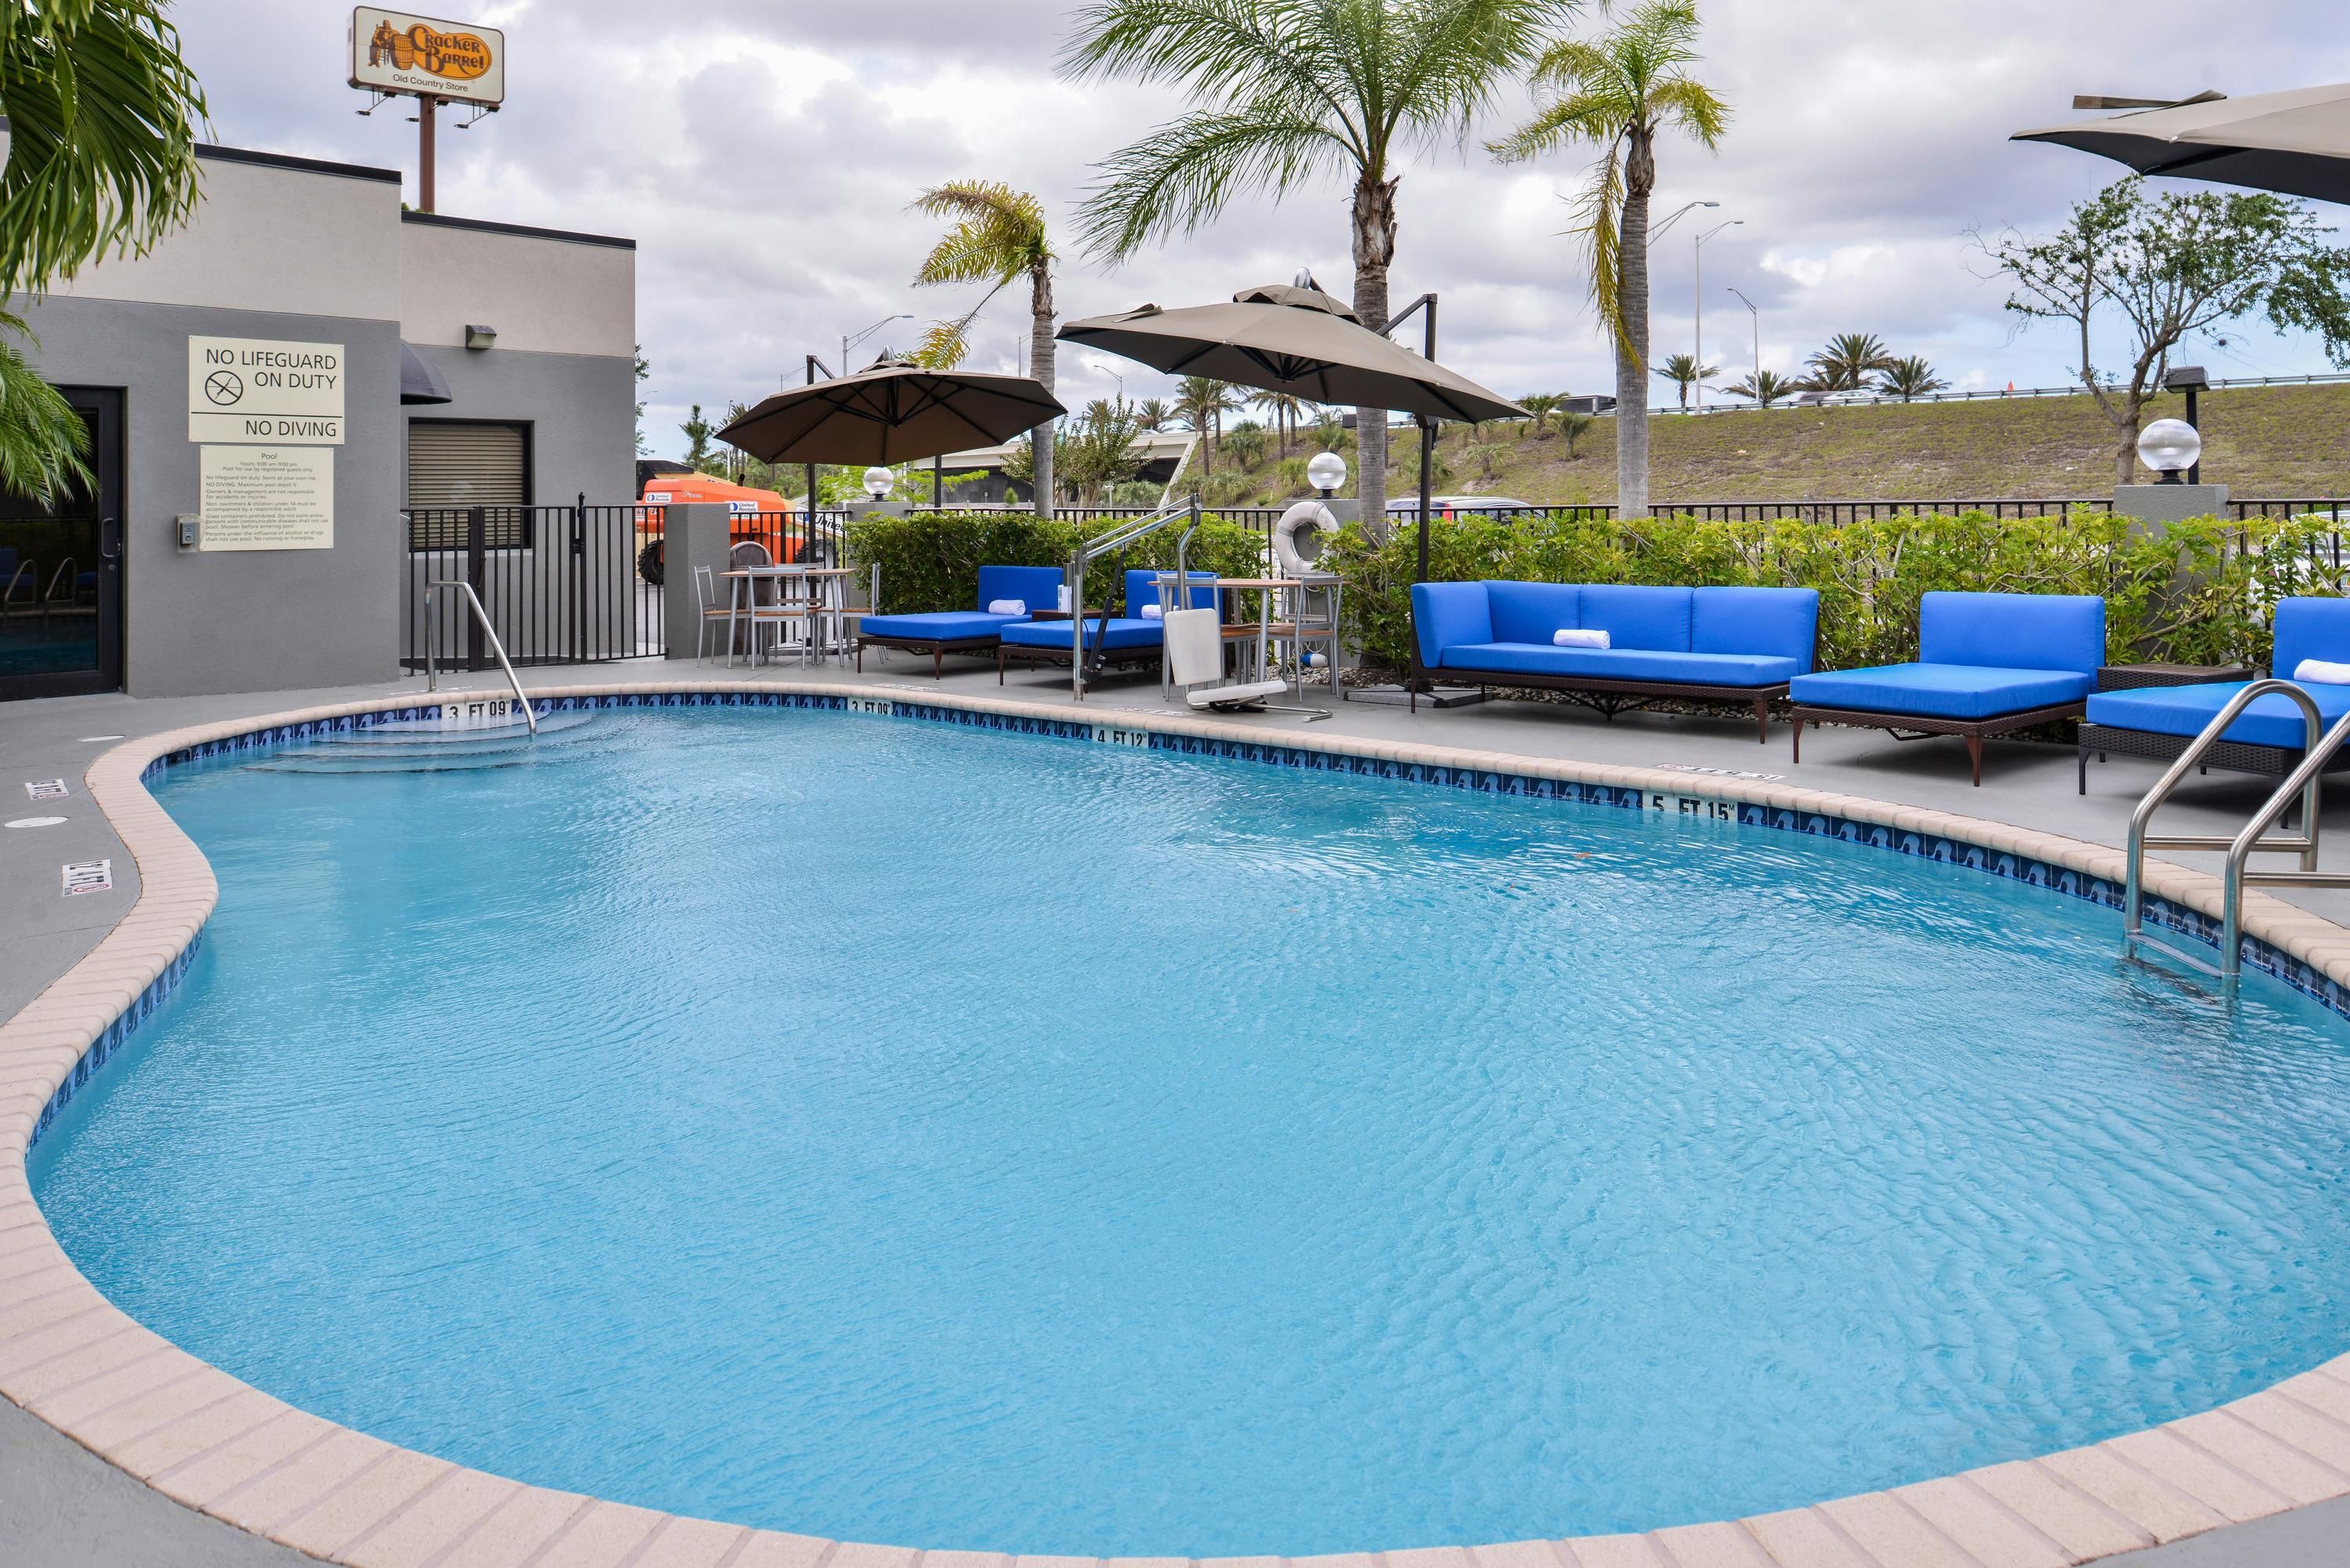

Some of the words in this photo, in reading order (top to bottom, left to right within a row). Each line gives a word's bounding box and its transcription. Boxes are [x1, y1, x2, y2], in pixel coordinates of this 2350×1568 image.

[393, 74, 408, 83] Old
[410, 76, 443, 90] Country
[445, 82, 468, 92] Store
[206, 349, 234, 365] NO
[242, 350, 336, 369] LIFEGUARD
[255, 372, 281, 387] ON
[289, 374, 336, 389] DUTY
[246, 420, 271, 435] NO
[278, 421, 336, 437] DIVING
[449, 706, 458, 718] 3
[469, 703, 484, 717] FT
[852, 701, 858, 711] 3
[865, 702, 875, 713] FT
[1098, 730, 1105, 742] 4
[1114, 731, 1126, 744] FT
[1652, 796, 1665, 812] 5
[1679, 798, 1701, 816] FT
